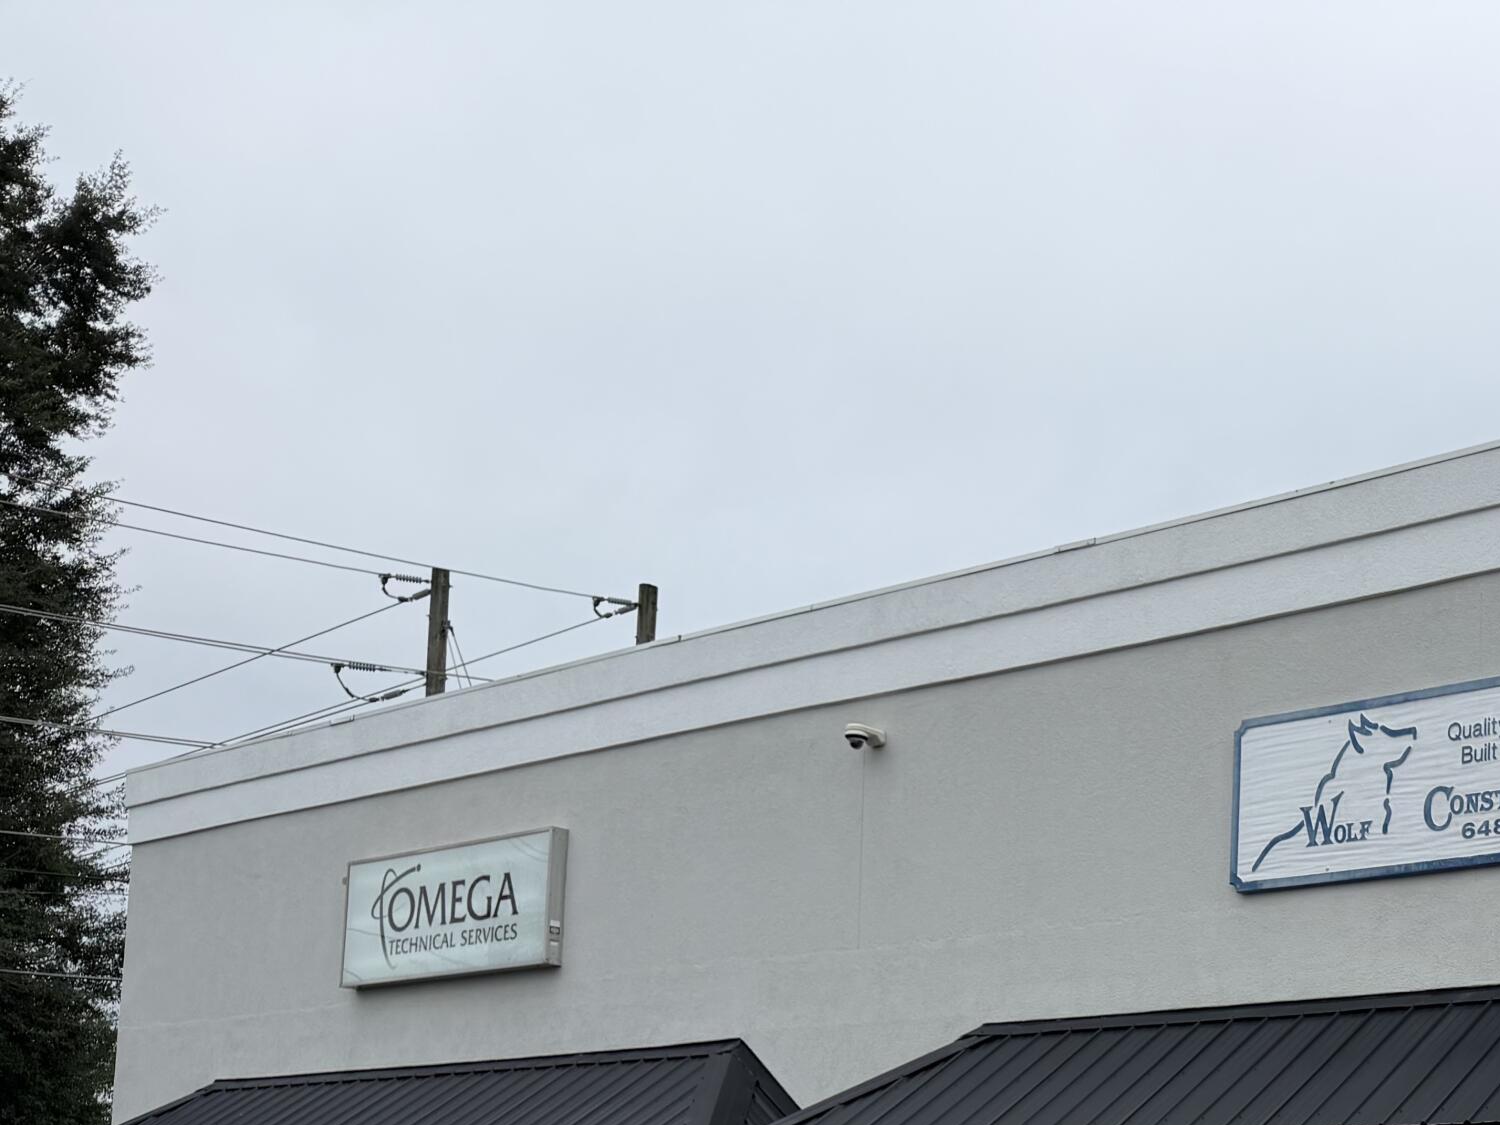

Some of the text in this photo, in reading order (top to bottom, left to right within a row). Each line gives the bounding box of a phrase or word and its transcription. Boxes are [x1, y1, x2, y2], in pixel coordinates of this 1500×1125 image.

[1460, 742, 1498, 765] Built
[1300, 789, 1373, 847] WOLF
[387, 871, 519, 933] OMEGA
[388, 923, 518, 956] TECHNICAL SERVICES
